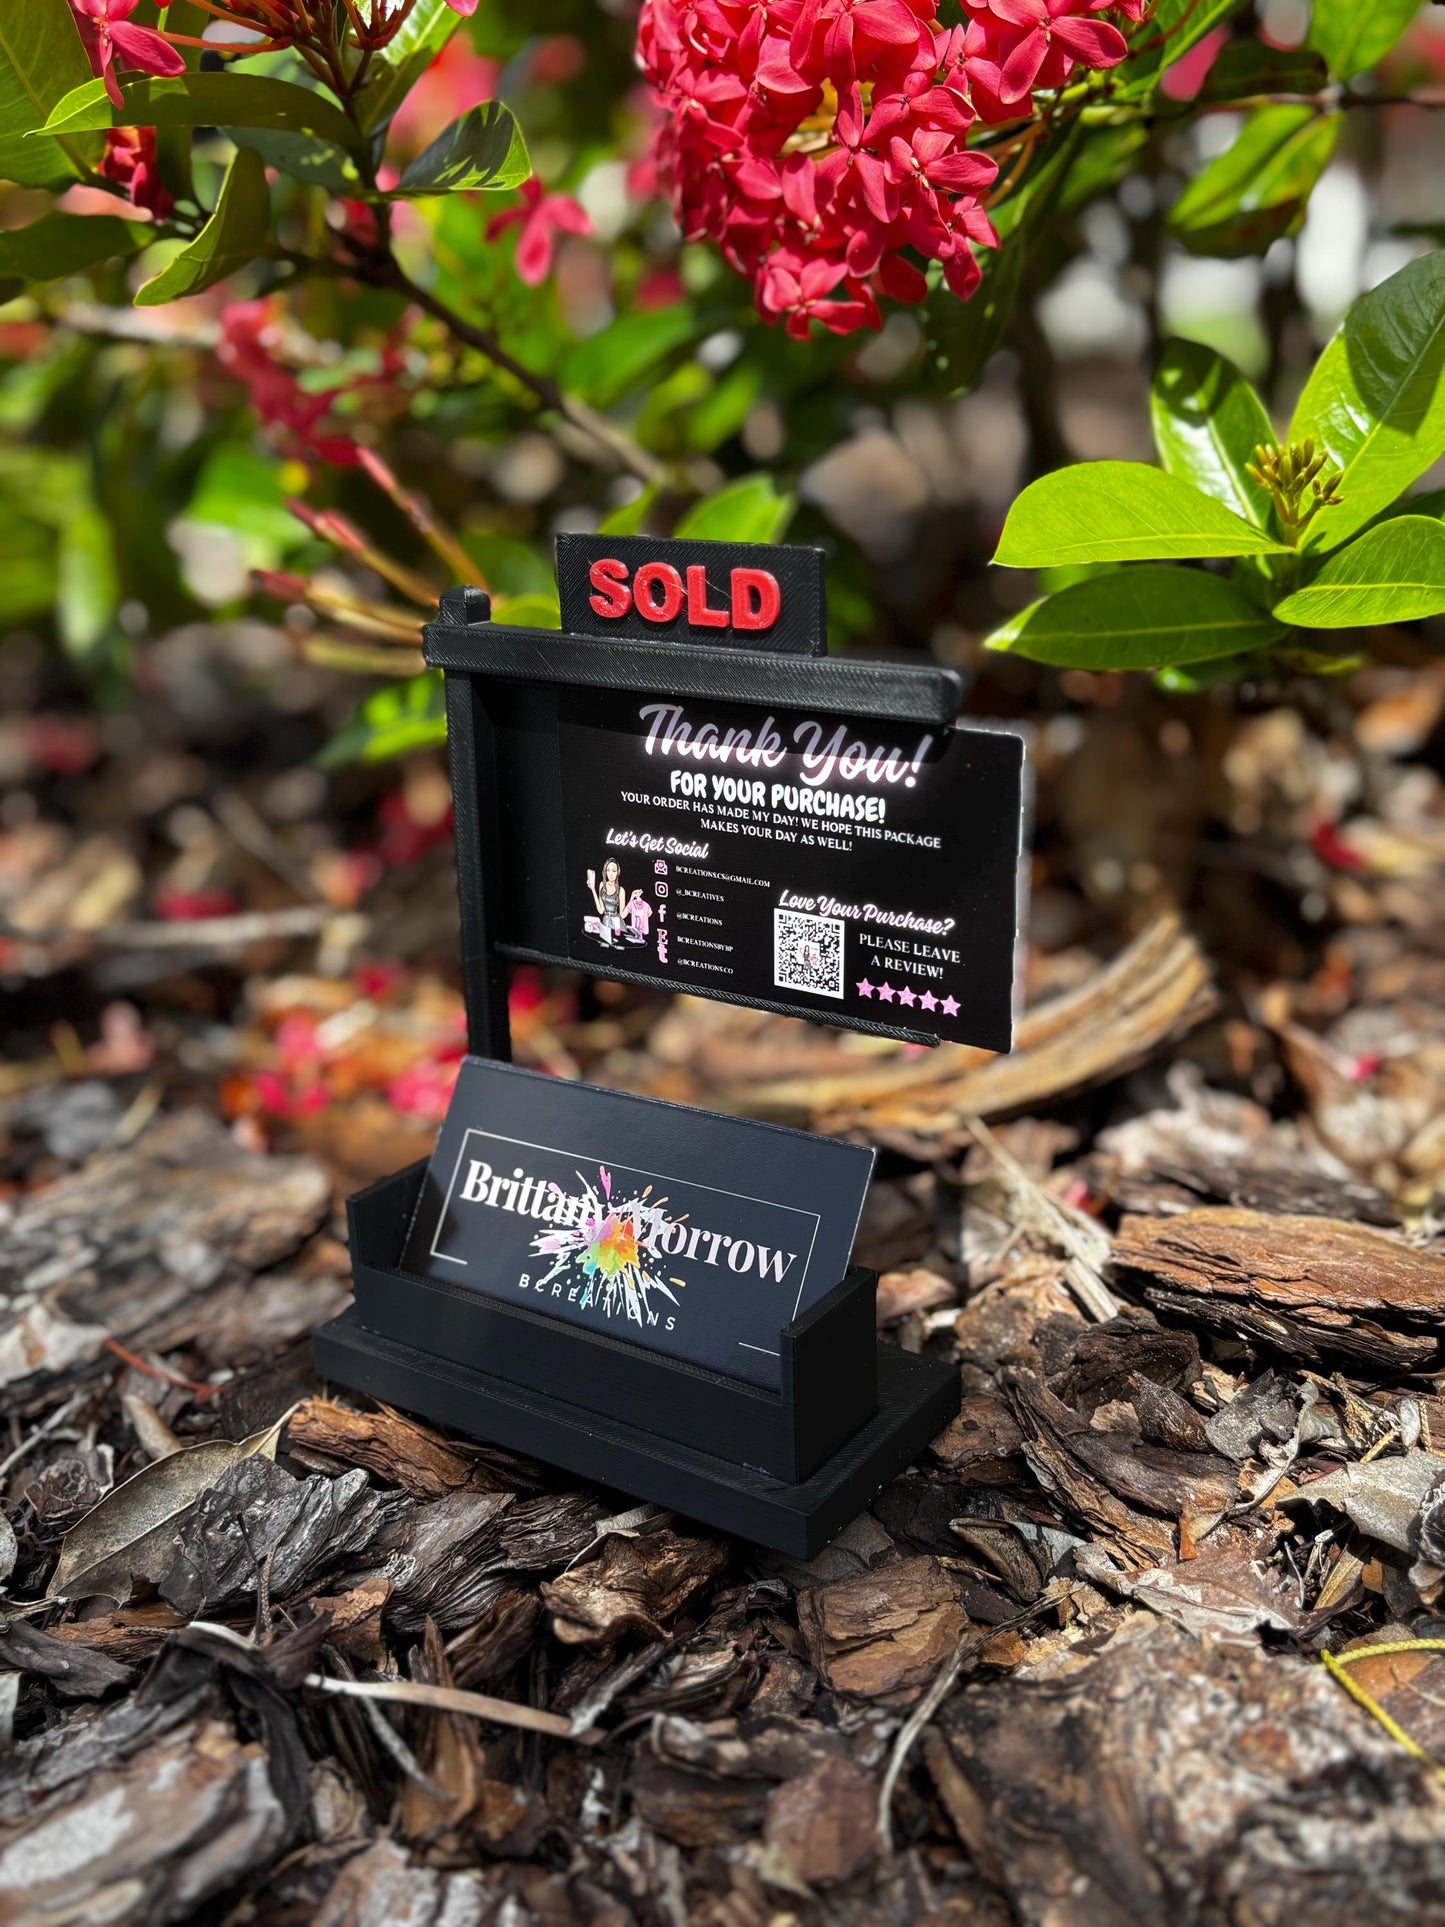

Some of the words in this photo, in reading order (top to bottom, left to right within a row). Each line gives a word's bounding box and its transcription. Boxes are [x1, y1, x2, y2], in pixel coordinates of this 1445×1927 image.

[588, 558, 781, 630] SOLD
[638, 703, 788, 768] Thank
[793, 720, 934, 787] You!
[670, 769, 707, 799] FOR
[711, 774, 766, 808] YOUR
[771, 783, 886, 824] PURCHASE!
[620, 790, 651, 806] YOUR
[652, 795, 691, 812] ORDER
[693, 800, 715, 815] HAS
[716, 804, 750, 820] MADE
[752, 809, 771, 823] MY
[772, 812, 799, 827] DAY!
[801, 816, 819, 831] WE
[821, 820, 853, 835] HOPE
[854, 824, 882, 840] THIS
[884, 829, 942, 849] PACKAGE
[700, 817, 739, 834] MAKES
[740, 824, 773, 840] YOUR
[775, 829, 798, 844] DAY
[800, 833, 816, 847] AS
[817, 835, 853, 852] WELL!
[605, 827, 639, 849] Let's
[639, 832, 666, 853] Get
[665, 837, 710, 860] Social
[676, 911, 723, 926] @BCREATIONS
[778, 889, 817, 911] Love
[816, 895, 863, 918] Your
[862, 903, 956, 936] Purchase?
[859, 933, 911, 954] PLEASE
[913, 942, 961, 964] LEAVE
[870, 954, 881, 967] A
[884, 957, 945, 980] REVIEW!
